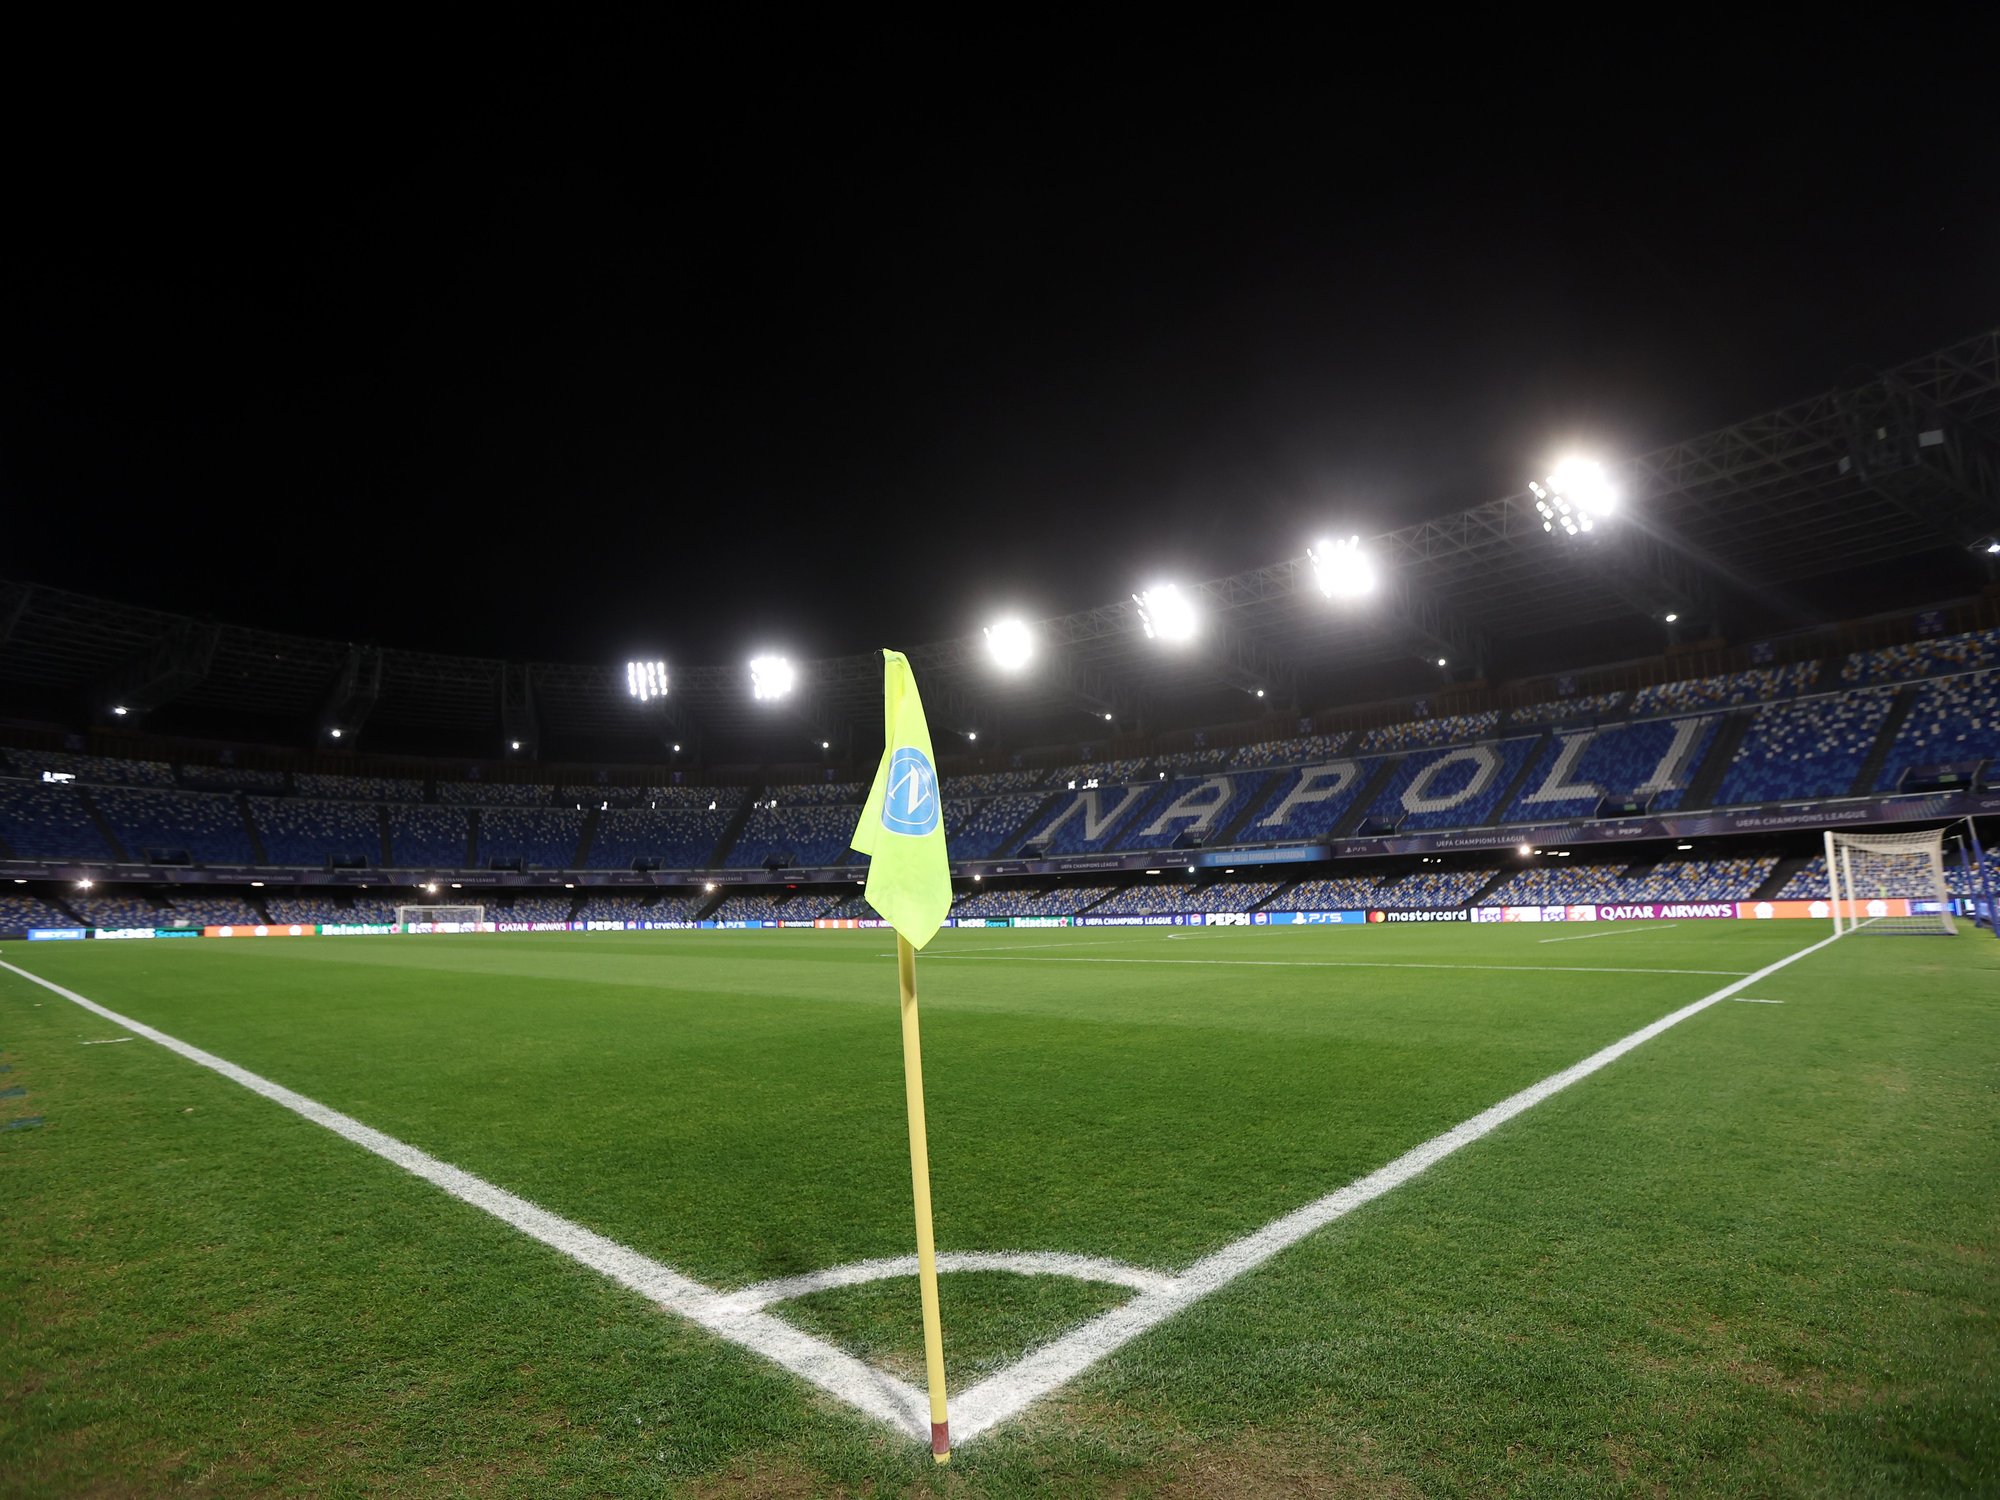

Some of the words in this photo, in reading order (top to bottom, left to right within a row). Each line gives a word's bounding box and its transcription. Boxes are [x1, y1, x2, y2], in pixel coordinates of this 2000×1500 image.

[1026, 716, 1712, 844] NAPOLI
[888, 764, 932, 815] N
[1736, 818, 1761, 827] UEFA
[1763, 813, 1823, 826] CHAMPIONS
[1825, 810, 1867, 821] LEAGUE
[1455, 837, 1496, 846] CHAMPIONS
[1498, 834, 1526, 843] LEAGUE
[1309, 912, 1342, 923] PS5
[1388, 909, 1468, 922] mastercard
[1600, 906, 1656, 921] QATAR
[1660, 904, 1733, 918] AIRWAYS
[958, 918, 985, 928] bet365
[985, 920, 1008, 928] Scores
[1014, 917, 1060, 928] Heineken
[1085, 918, 1103, 926] UEFA
[1104, 917, 1144, 926] CHAMPIONS
[1144, 916, 1172, 926] LEAGUE
[1205, 912, 1250, 926] PEPSI
[498, 923, 529, 932] QATAR
[530, 922, 567, 932] AIRWAYS
[587, 921, 624, 931] PEPSI
